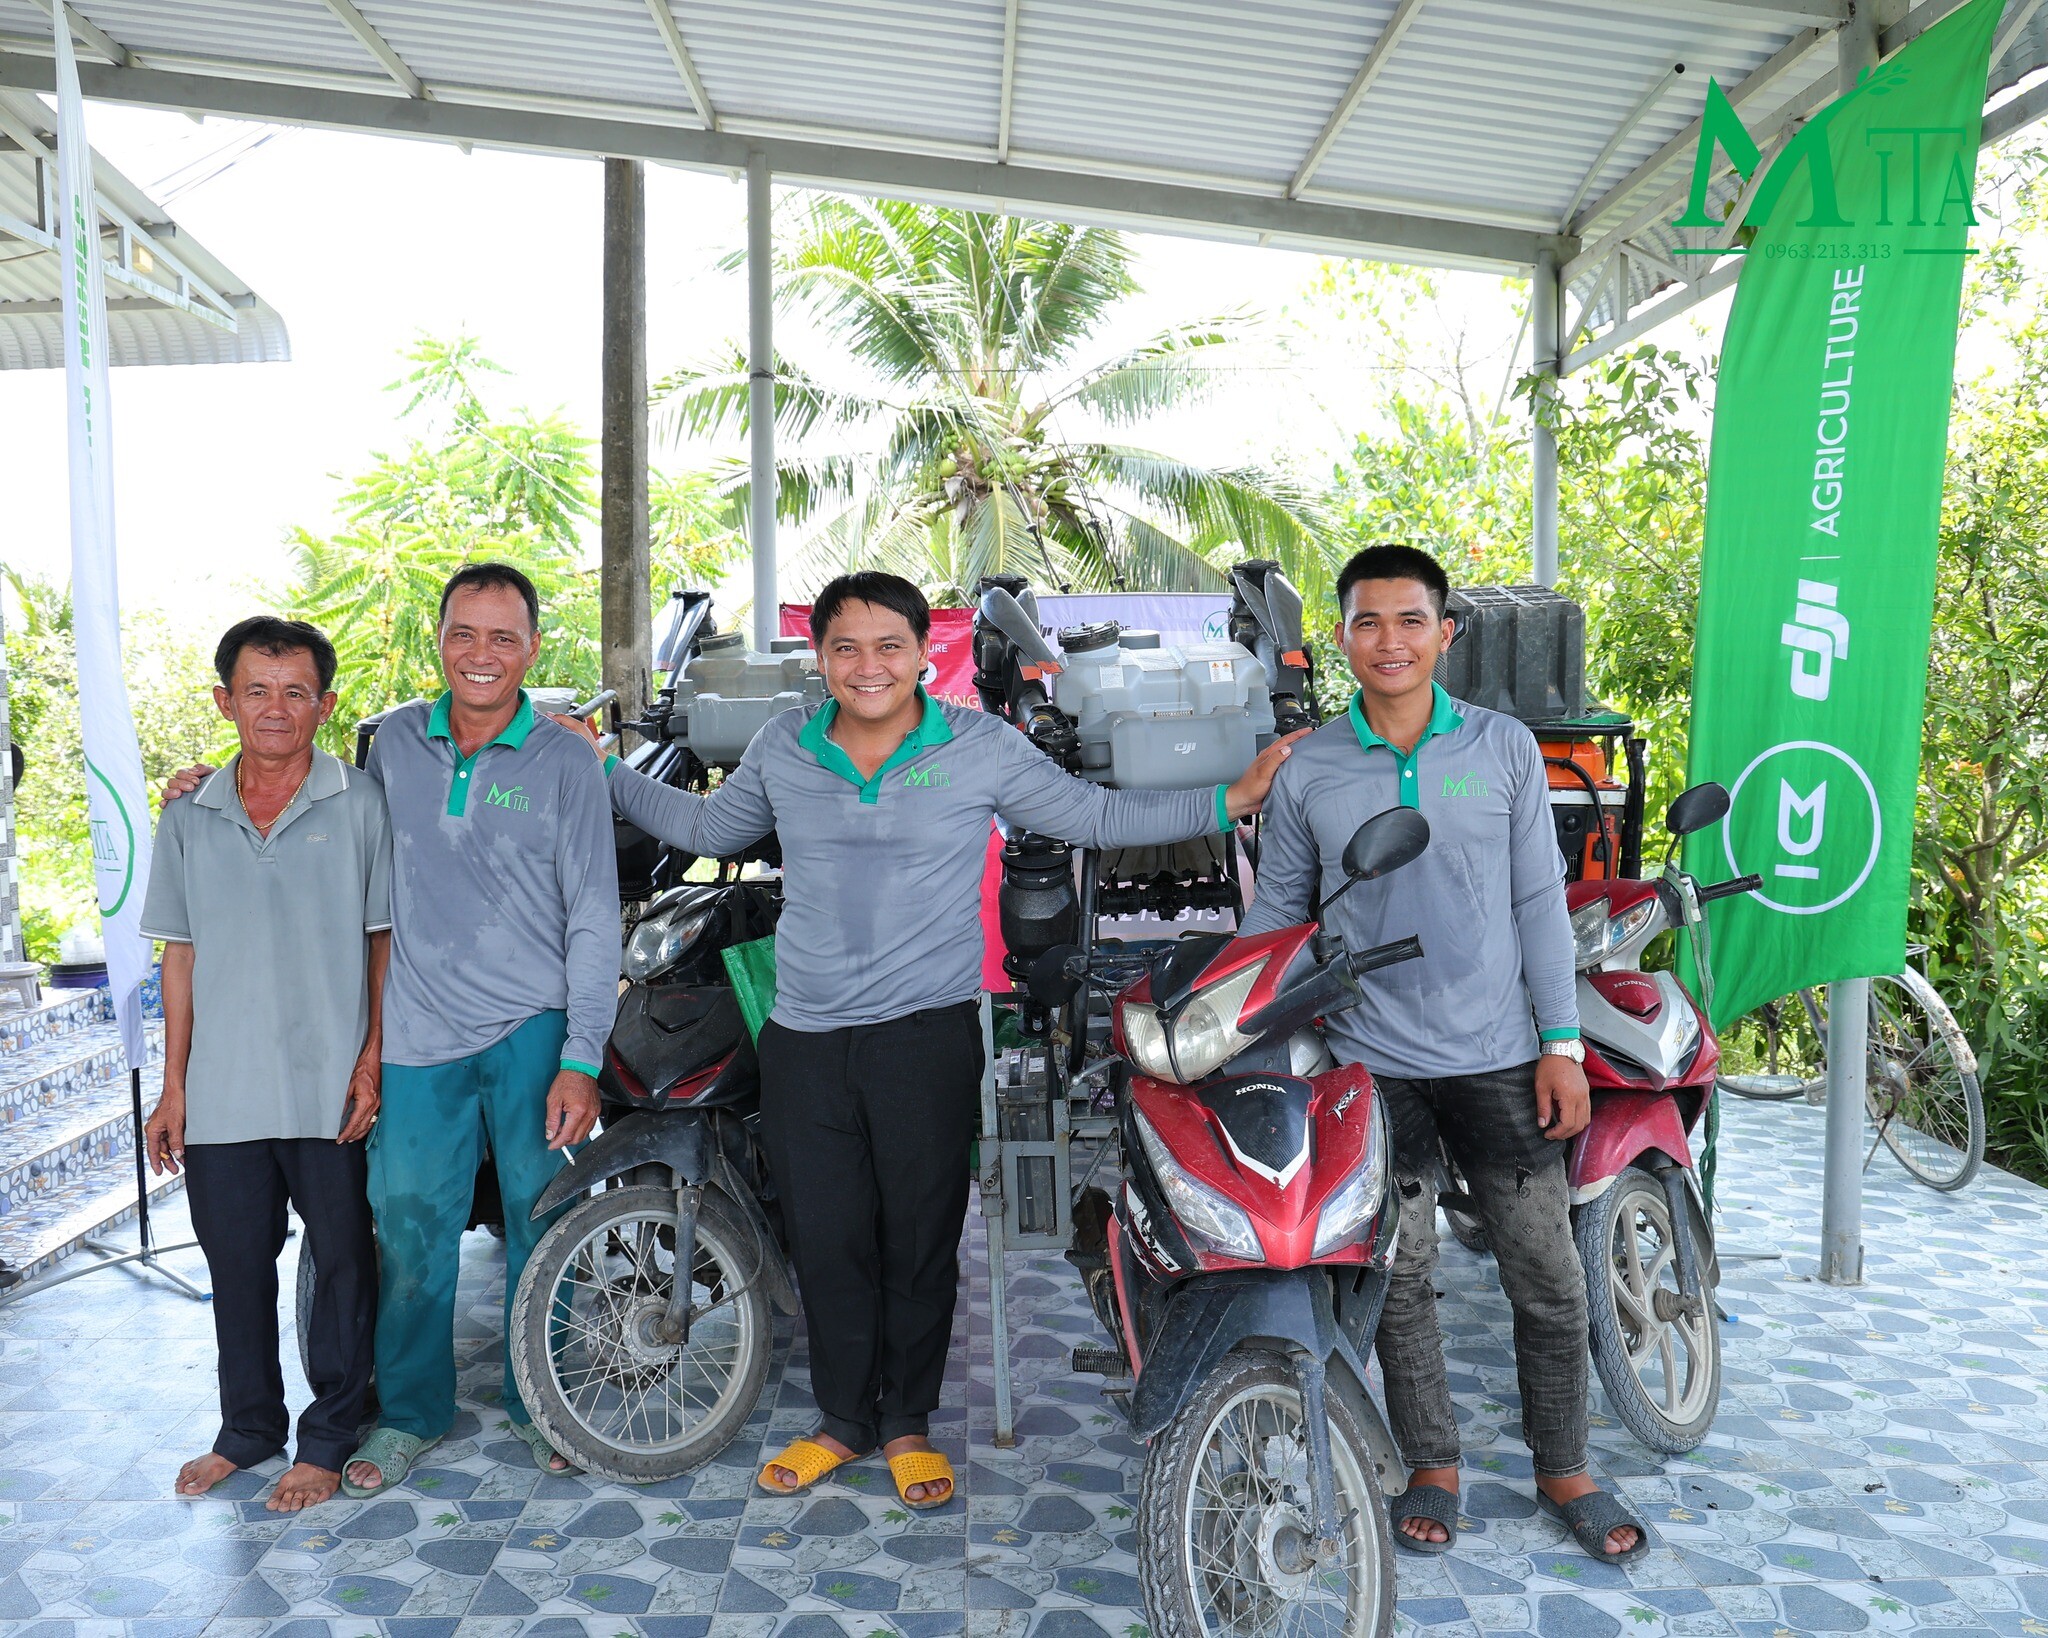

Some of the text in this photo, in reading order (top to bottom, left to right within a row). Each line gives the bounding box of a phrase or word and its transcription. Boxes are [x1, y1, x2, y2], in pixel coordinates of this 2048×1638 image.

[1809, 264, 1865, 538] AGRICULTURE
[1613, 980, 1654, 990] HONDA
[1235, 1083, 1288, 1097] HONDA
